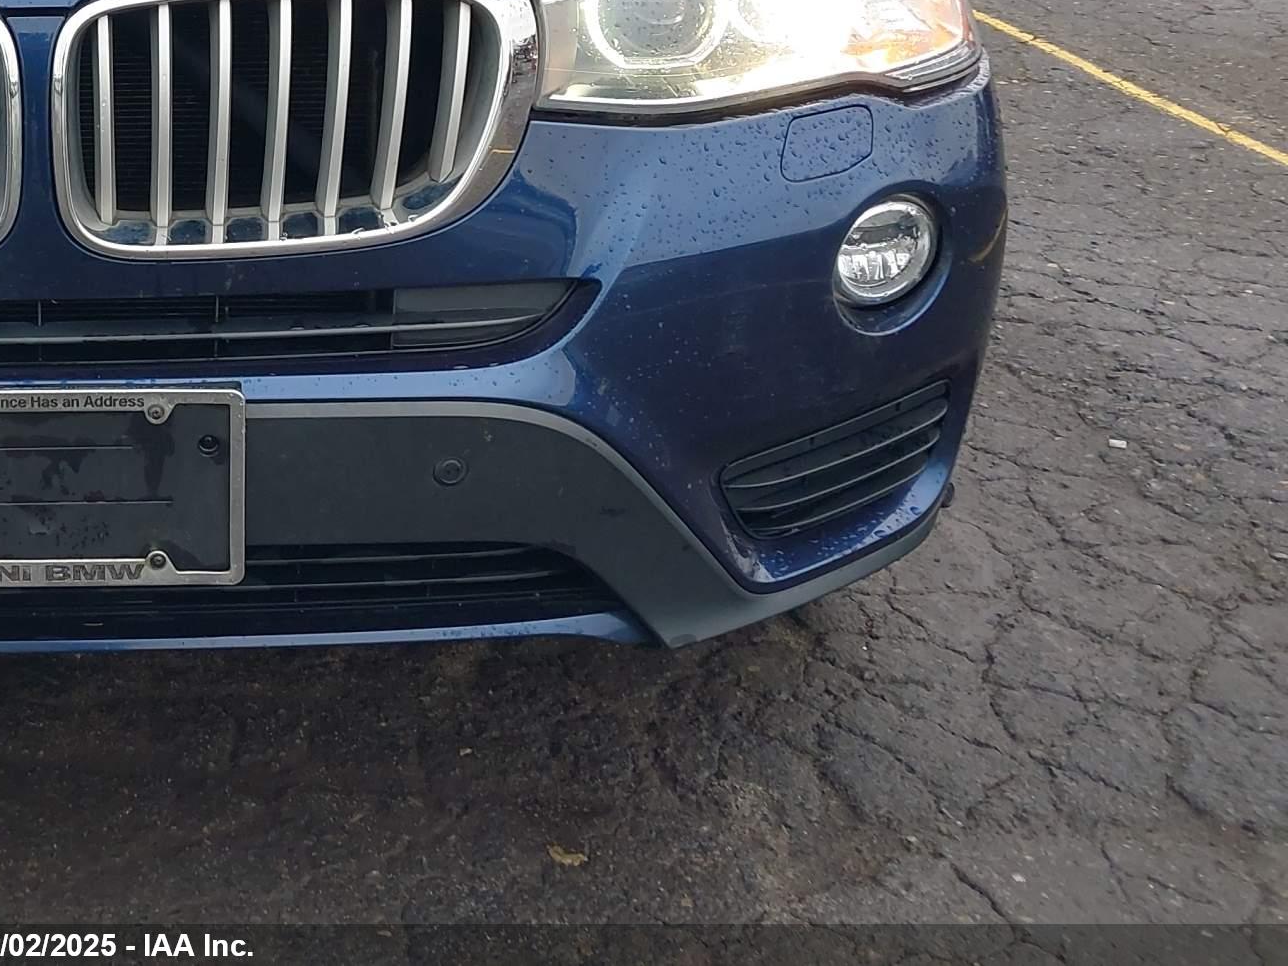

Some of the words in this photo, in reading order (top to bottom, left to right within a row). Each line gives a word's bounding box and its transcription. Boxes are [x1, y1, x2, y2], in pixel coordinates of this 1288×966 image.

[30, 396, 59, 408] Has
[62, 397, 80, 408] an
[83, 395, 145, 408] Address
[45, 564, 145, 582] BMW
